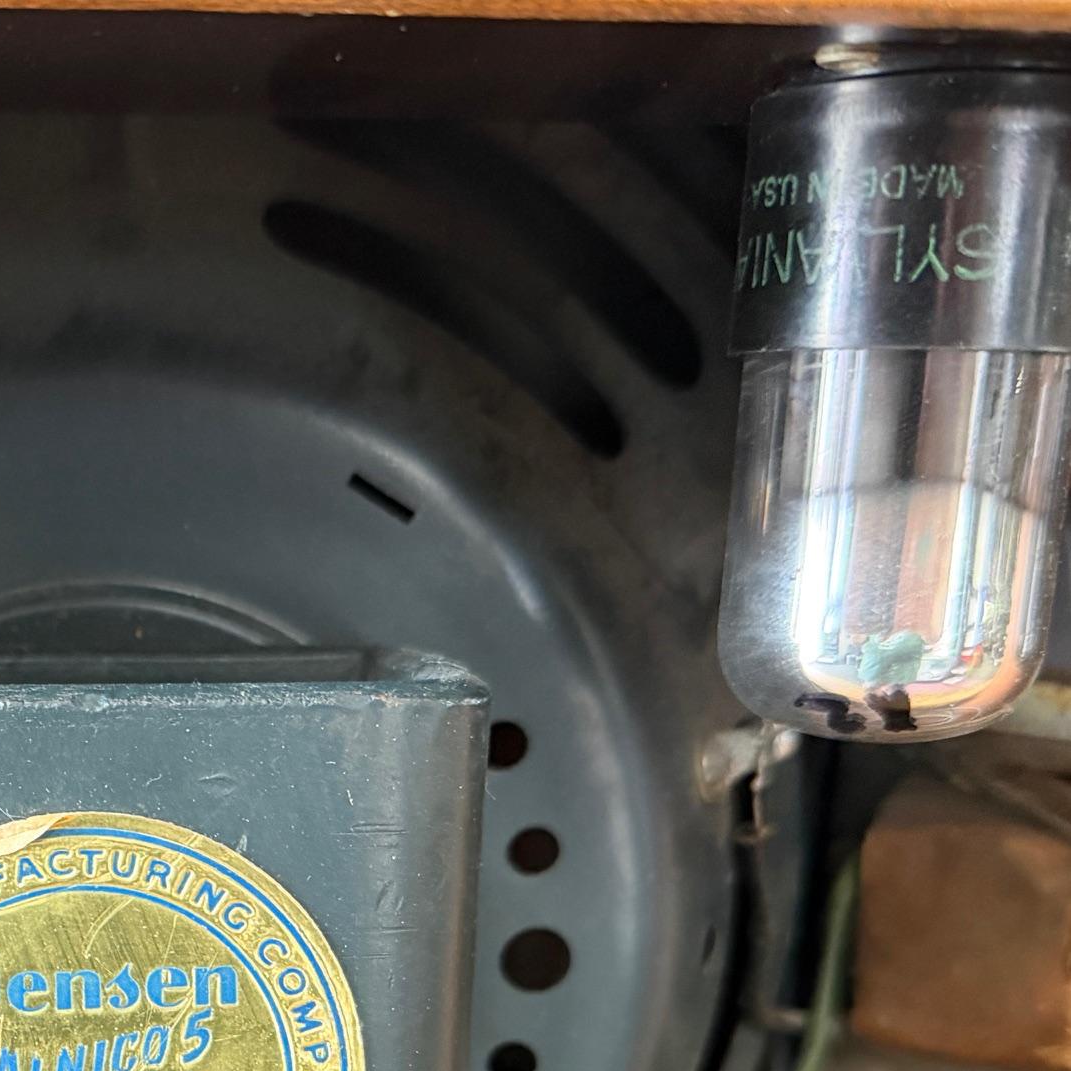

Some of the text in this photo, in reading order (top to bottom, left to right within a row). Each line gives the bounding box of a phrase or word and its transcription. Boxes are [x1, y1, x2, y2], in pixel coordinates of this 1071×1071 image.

[862, 163, 964, 200] MADE
[732, 223, 999, 289] SYLANIA
[181, 1007, 214, 1064] 5
